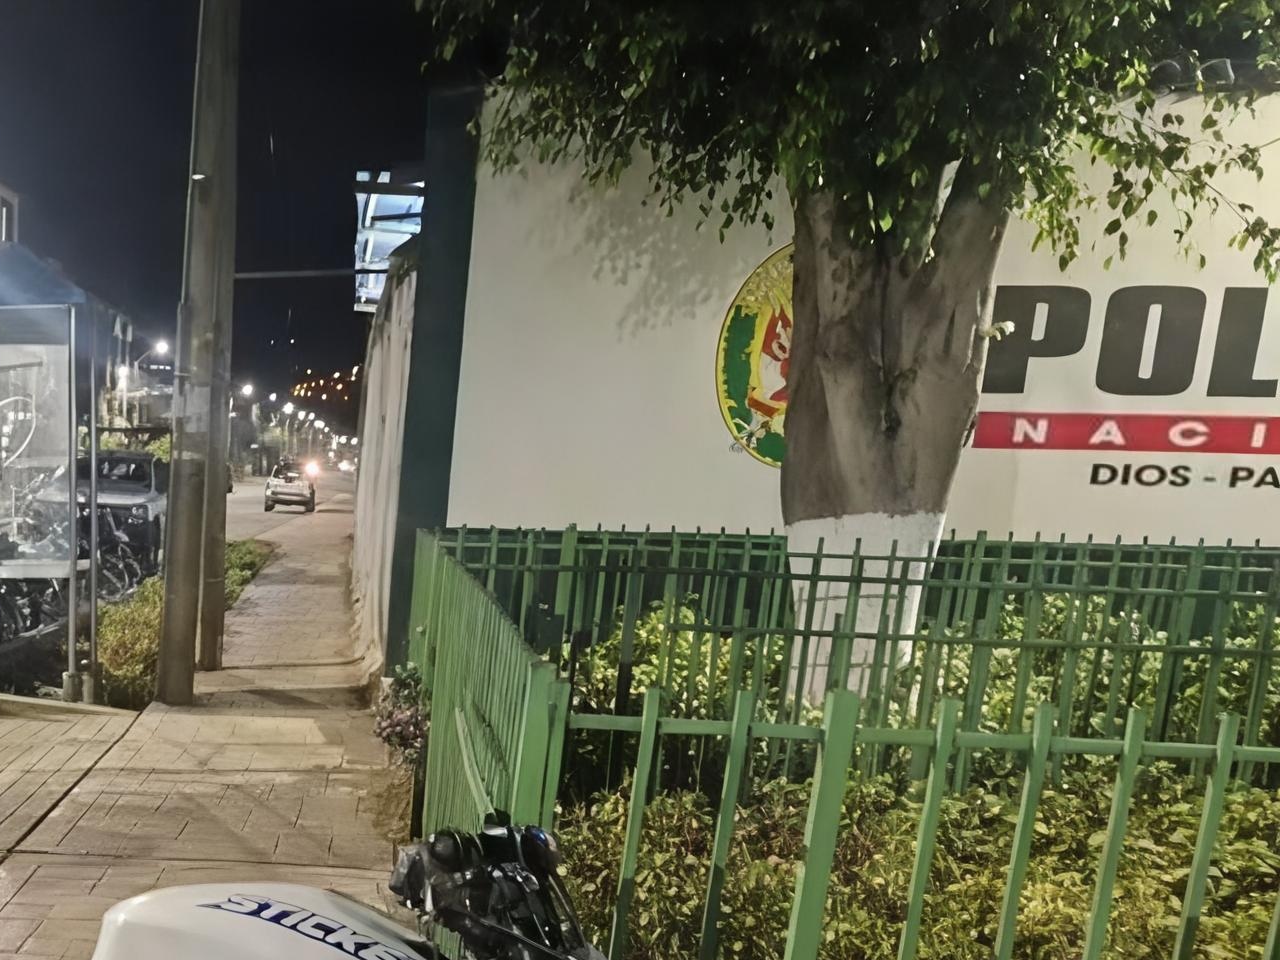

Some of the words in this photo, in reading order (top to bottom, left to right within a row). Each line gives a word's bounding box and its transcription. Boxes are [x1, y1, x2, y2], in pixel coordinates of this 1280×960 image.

[981, 285, 1279, 398] POL
[1089, 463, 1192, 487] DIOS
[1228, 466, 1280, 489] PA
